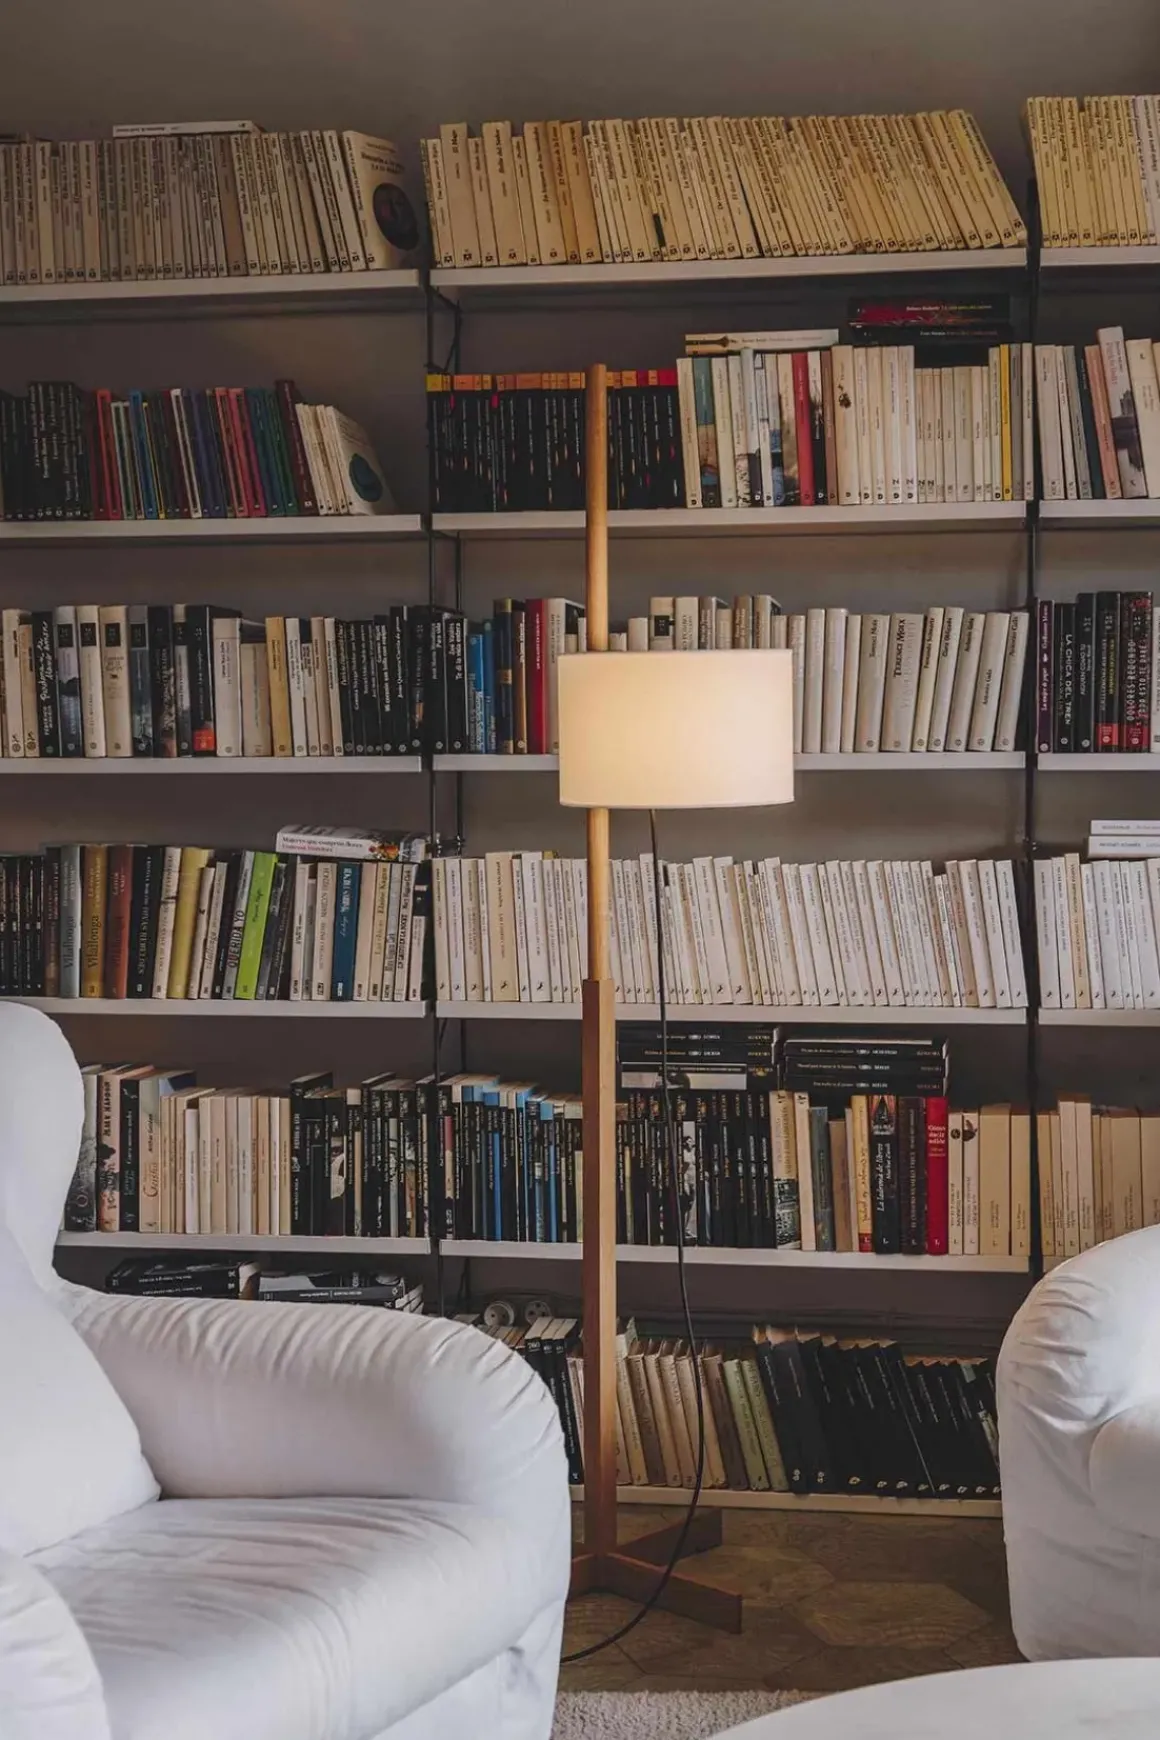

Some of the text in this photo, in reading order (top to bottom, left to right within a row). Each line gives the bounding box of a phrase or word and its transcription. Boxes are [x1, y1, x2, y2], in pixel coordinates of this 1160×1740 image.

[1143, 100, 1152, 129] americano
[766, 193, 776, 213] Manual
[923, 618, 935, 668] Fernando Schwartz
[964, 632, 972, 652] Antonio
[1009, 632, 1017, 656] Antonio
[894, 644, 903, 677] TERENCI
[1126, 641, 1136, 720] DOLORES REDONDO
[318, 839, 344, 847] compran
[376, 893, 385, 913] Elaine
[140, 907, 149, 930] DIVAS
[63, 917, 77, 969] Vilallonga
[87, 916, 100, 968] Vilallonga
[138, 932, 148, 974] REBELDES
[228, 927, 243, 968] QUERIDA
[876, 1174, 884, 1199] ladrona
